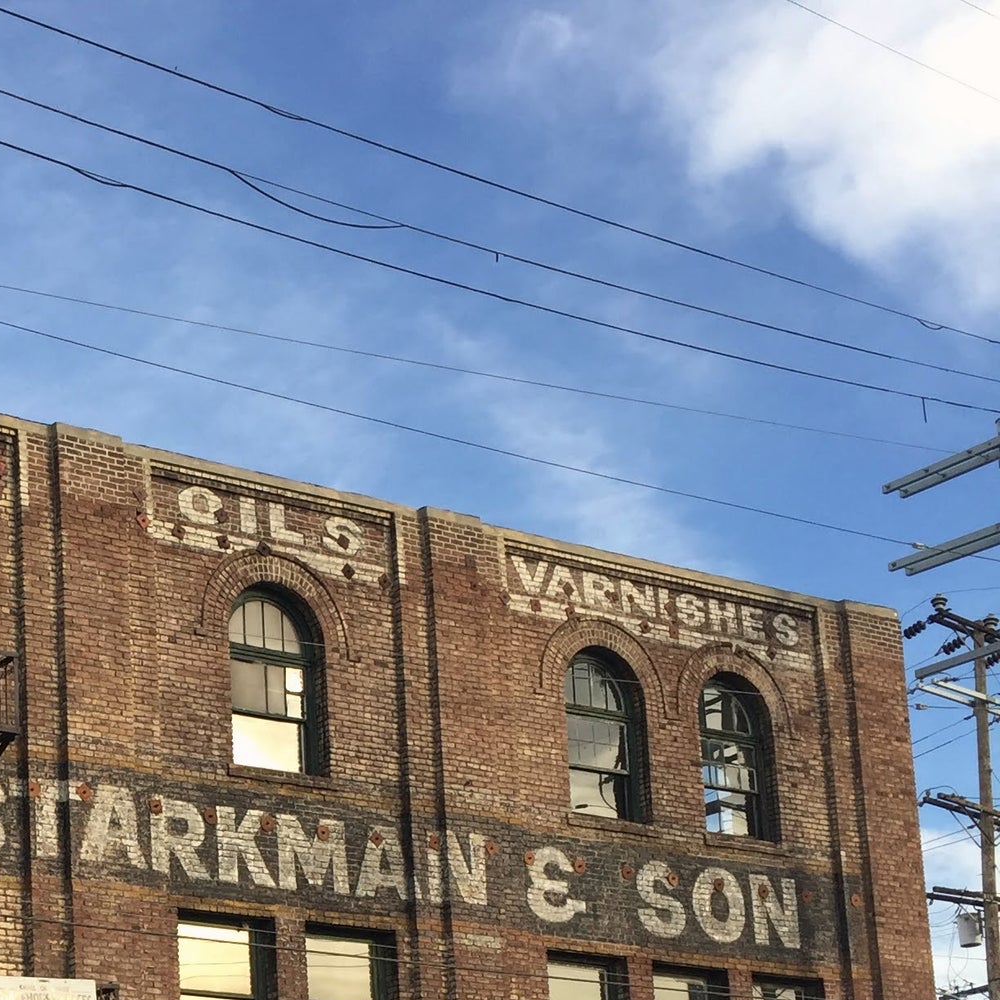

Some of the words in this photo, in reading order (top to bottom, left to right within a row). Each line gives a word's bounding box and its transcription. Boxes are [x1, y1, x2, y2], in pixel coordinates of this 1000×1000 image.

[177, 484, 364, 556] OILS
[509, 554, 799, 646] VARNISHES
[527, 846, 587, 924] &
[636, 860, 801, 949] SON
